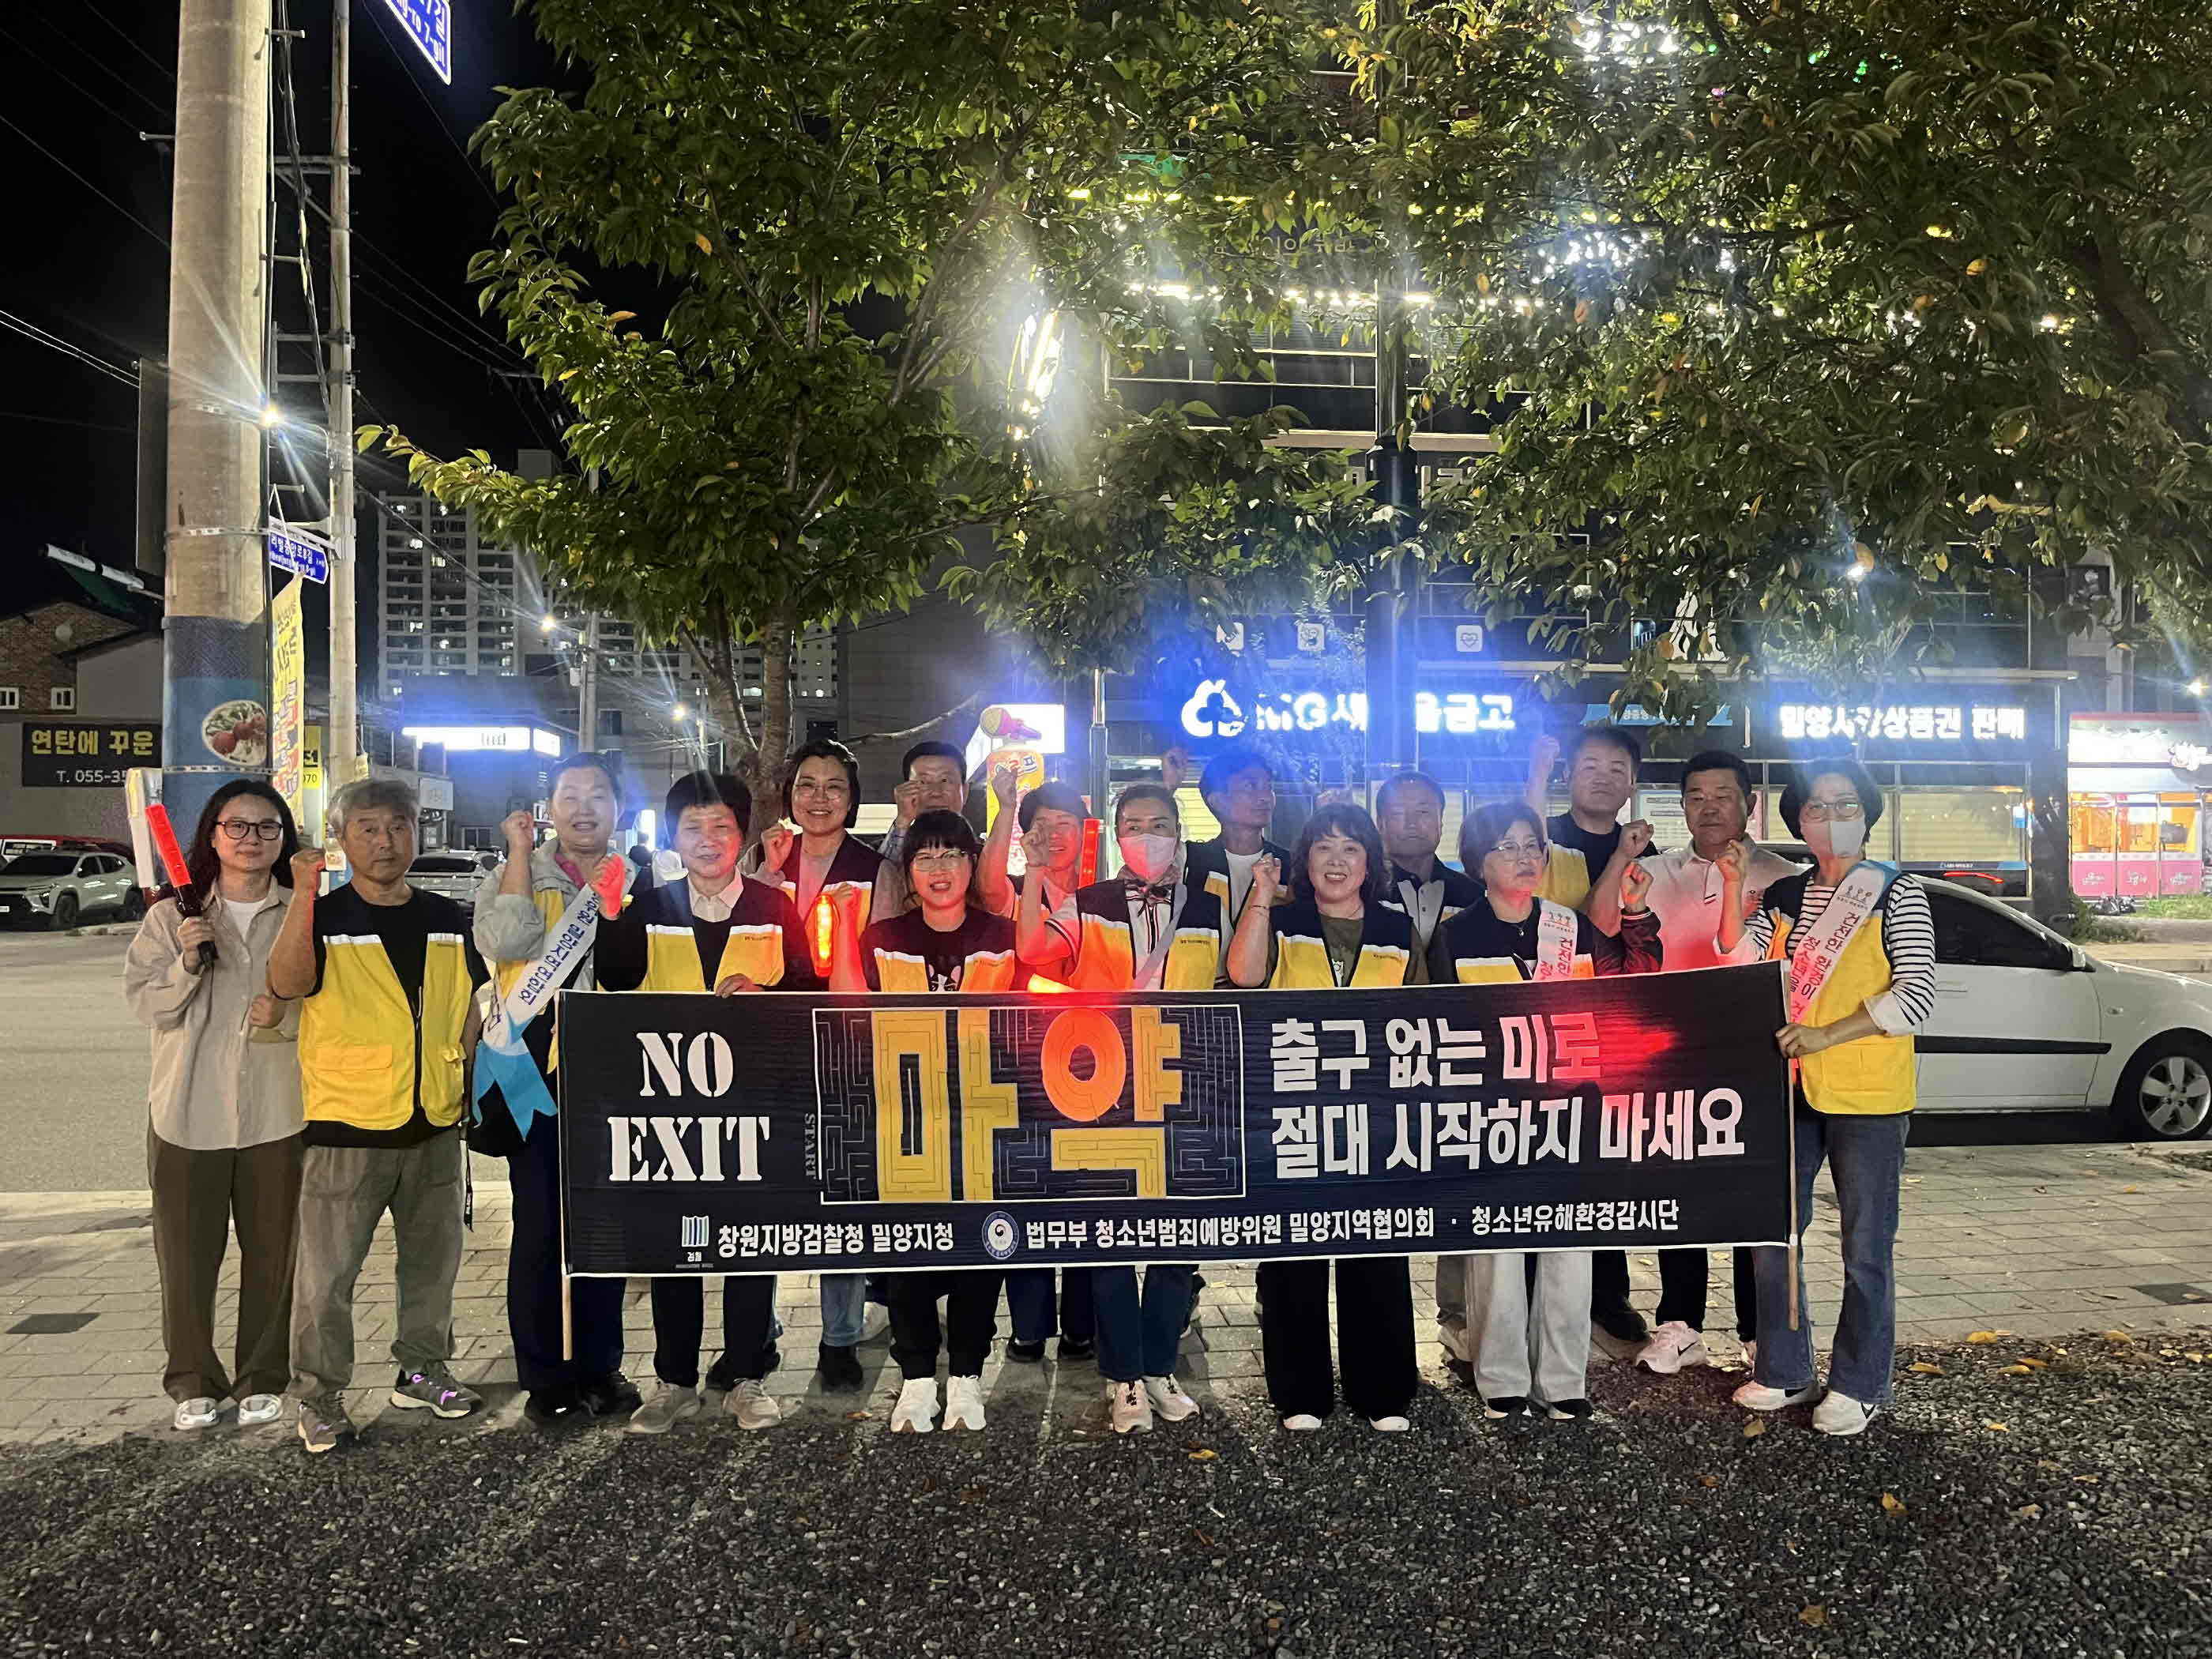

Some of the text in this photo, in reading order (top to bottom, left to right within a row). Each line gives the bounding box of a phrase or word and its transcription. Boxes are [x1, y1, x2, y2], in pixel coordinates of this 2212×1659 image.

[32, 730, 153, 755] 연탄에 꾸운
[1971, 706, 2026, 740] 판매
[56, 770, 70, 783] T.
[1826, 911, 1860, 954] 건전한
[636, 1032, 734, 1097] NO
[1270, 1011, 1602, 1093] 출구 없는 미로
[871, 1006, 1183, 1202] 마약
[1271, 1087, 1745, 1179] 절대 시작하지 마세요
[608, 1116, 770, 1182] EXIT
[803, 1112, 815, 1179] START
[717, 1223, 864, 1258] 창원지방검찰청
[871, 1222, 954, 1253] 밀양지청
[1026, 1221, 1088, 1249] 법무부
[1095, 1213, 1281, 1248] 청소년범죄예방위원
[1289, 1206, 1434, 1243] 밀양지역협의회
[1472, 1198, 1680, 1236] 청소년유해환경감시단
